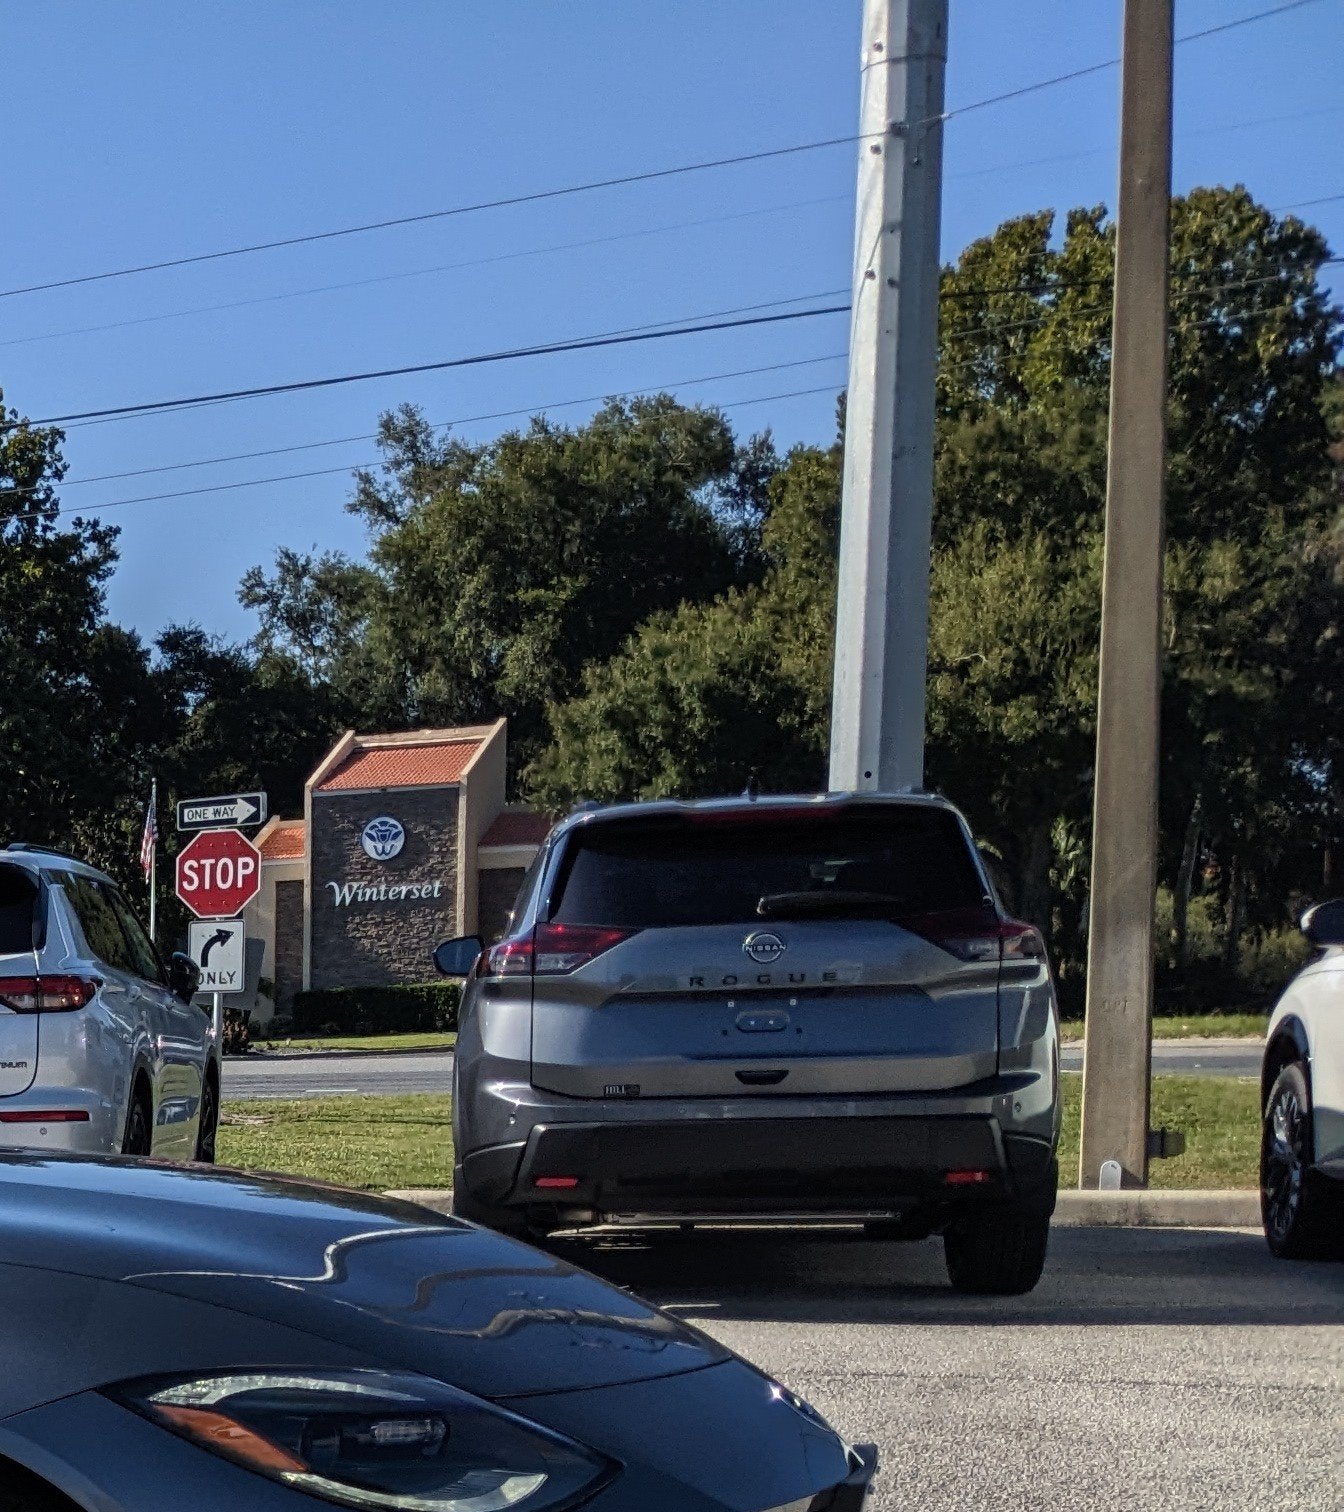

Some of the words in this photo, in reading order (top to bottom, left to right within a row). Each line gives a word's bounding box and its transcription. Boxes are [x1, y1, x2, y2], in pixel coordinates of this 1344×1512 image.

[186, 808, 209, 821] ONE
[212, 805, 236, 817] WAY
[182, 856, 255, 891] STOP
[325, 877, 443, 906] Winterset
[689, 972, 837, 987] ROGUE
